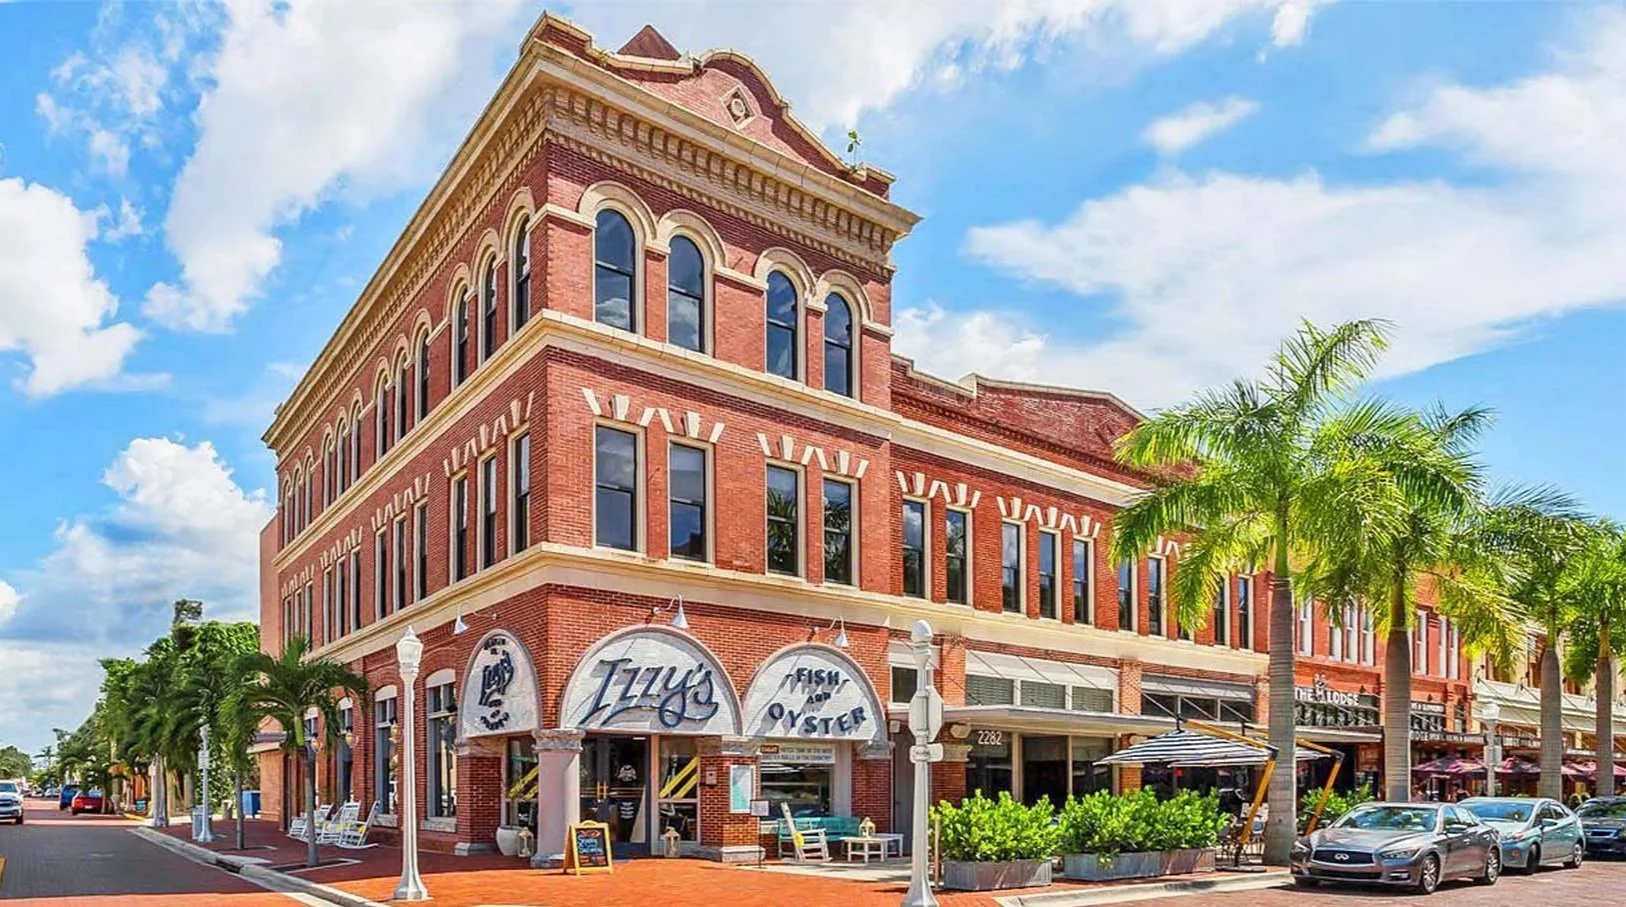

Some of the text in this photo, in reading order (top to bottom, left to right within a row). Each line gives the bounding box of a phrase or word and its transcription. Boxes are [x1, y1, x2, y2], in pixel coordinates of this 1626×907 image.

[796, 667, 840, 686] FISH
[579, 657, 719, 728] Izzy's
[806, 691, 831, 704] AND
[1294, 686, 1360, 706] THE LODGE
[768, 702, 867, 735] OYSTER
[977, 730, 1003, 746] 2282
